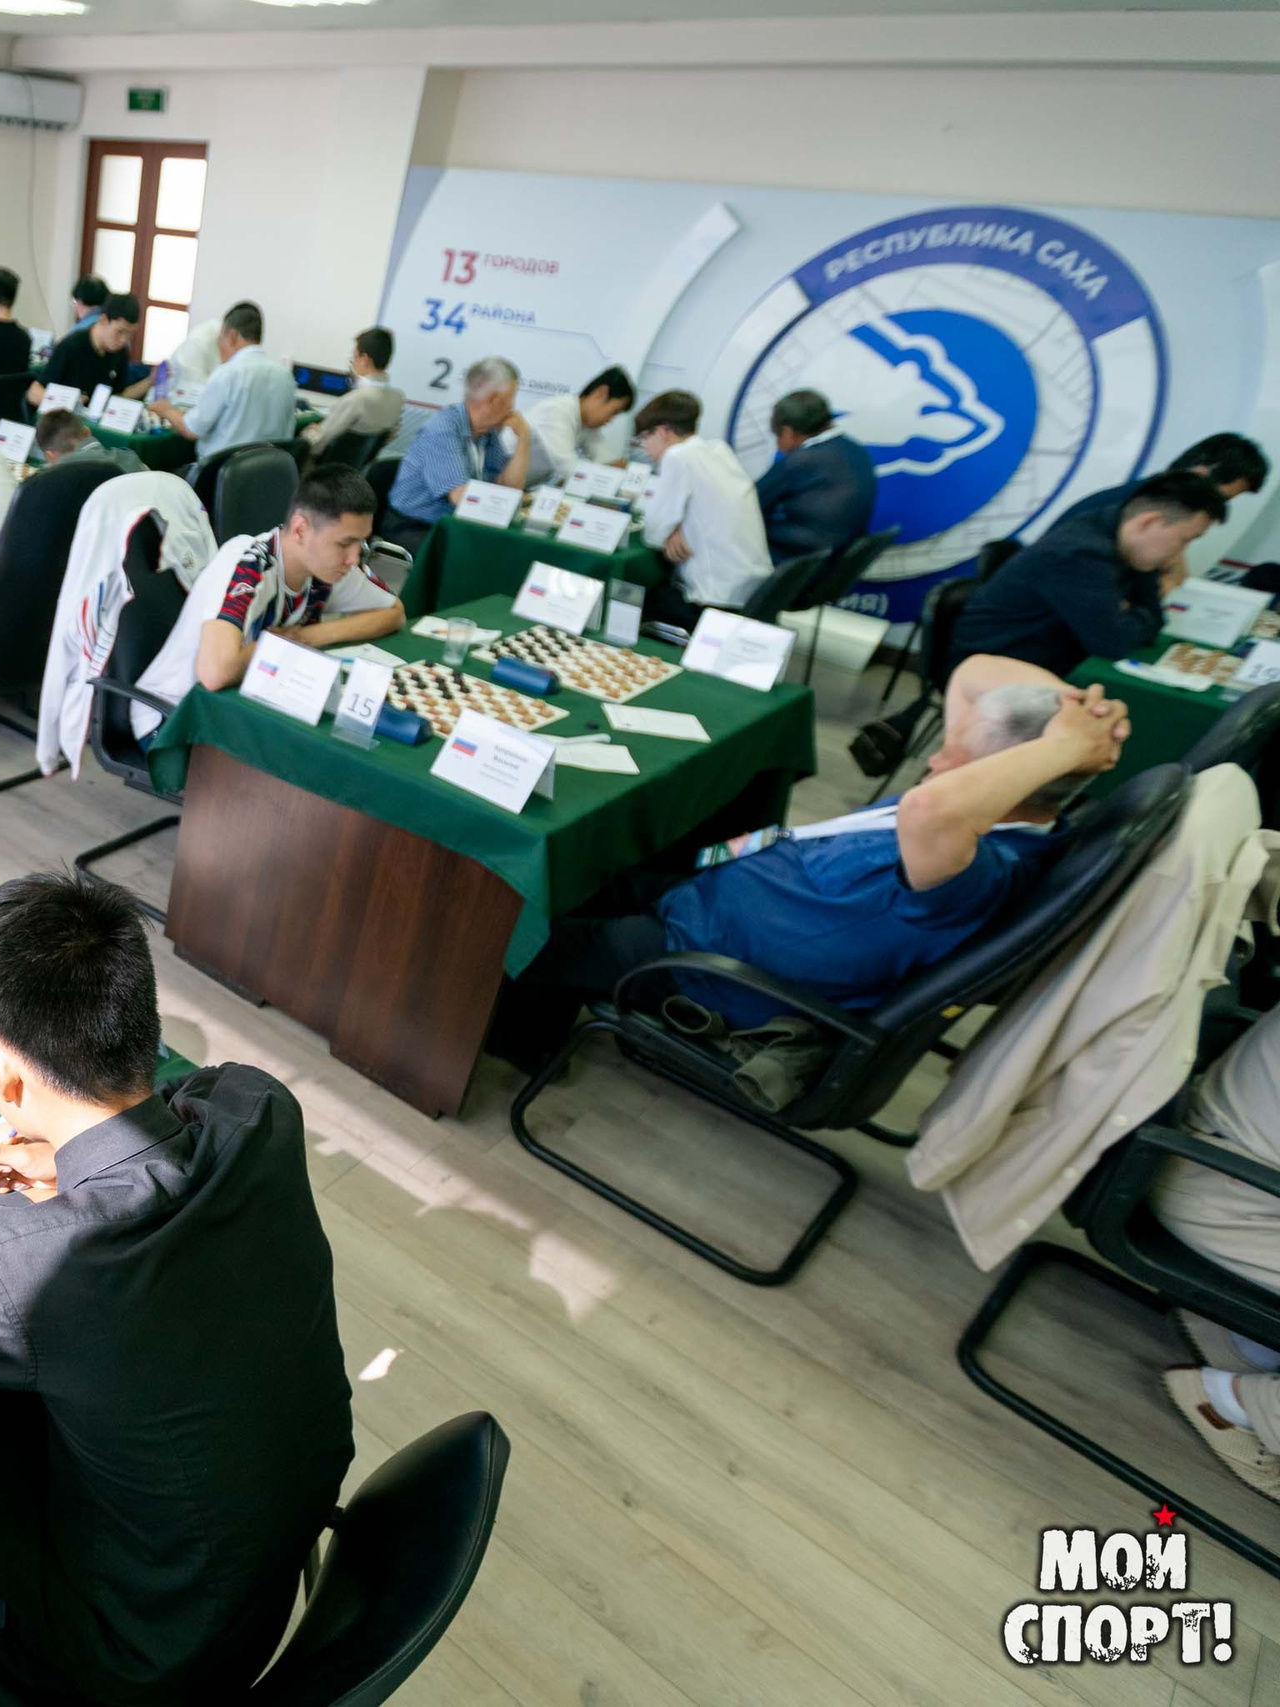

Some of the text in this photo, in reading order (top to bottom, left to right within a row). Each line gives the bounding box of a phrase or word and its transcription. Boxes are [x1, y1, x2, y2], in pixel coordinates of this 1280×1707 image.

[442, 248, 560, 285] 13 ГОРОДОВ
[823, 222, 1109, 300] РЕСПУБЛИКА САХА
[418, 298, 536, 334] 34 РАЙОНА
[429, 357, 453, 390] 2
[346, 692, 376, 719] 15
